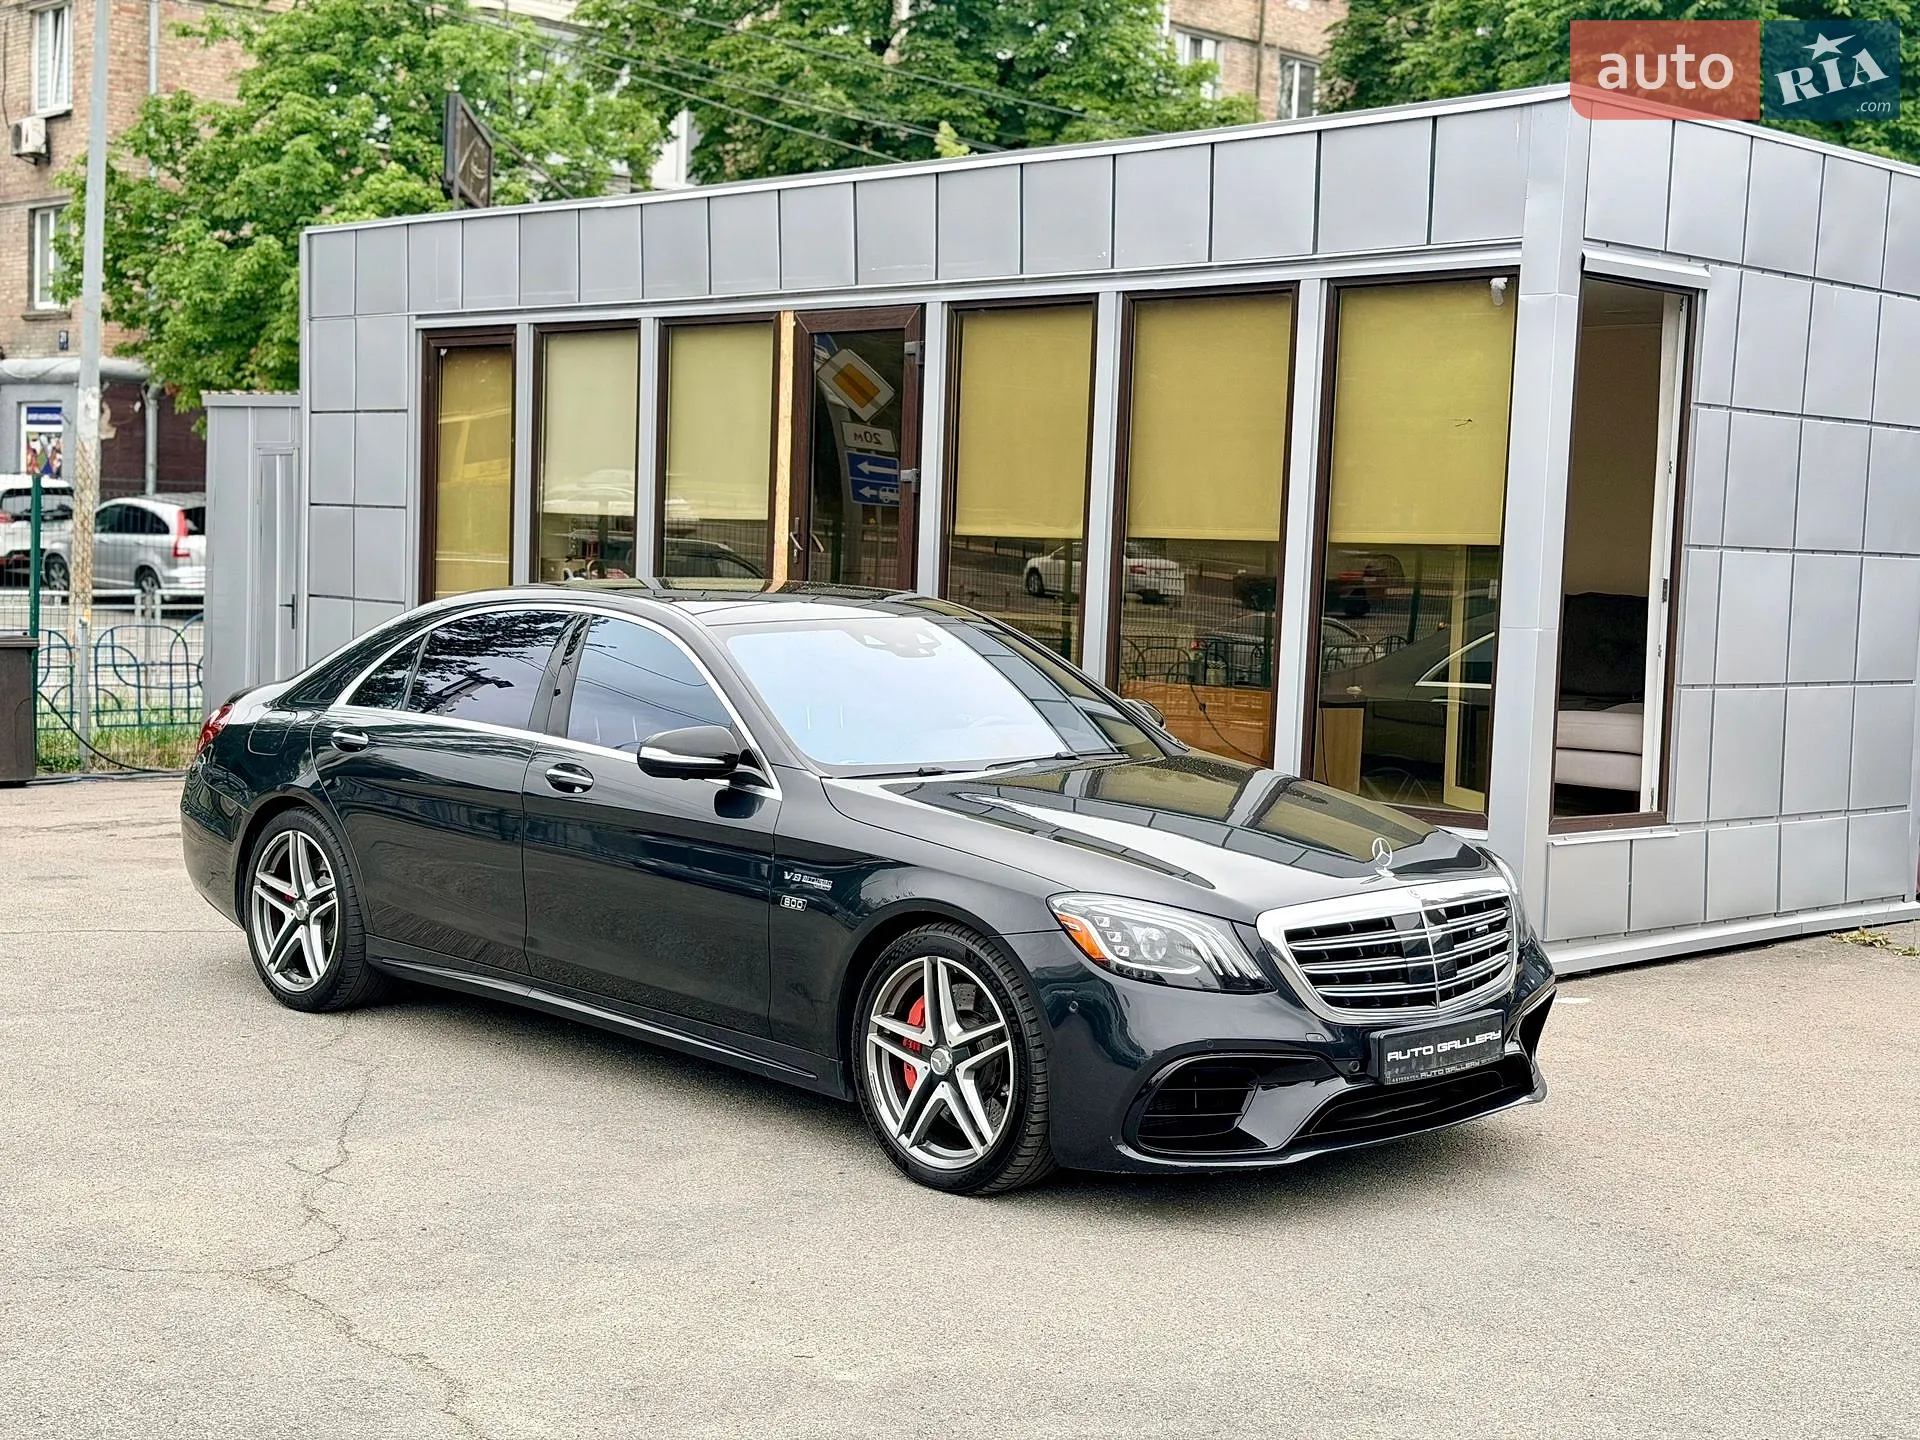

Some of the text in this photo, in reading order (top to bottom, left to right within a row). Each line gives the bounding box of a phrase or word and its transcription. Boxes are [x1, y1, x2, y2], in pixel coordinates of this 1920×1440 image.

[783, 871, 802, 882] V8
[1387, 1030, 1502, 1062] AUTO GALLERY
[1420, 1069, 1444, 1079] AUTO
